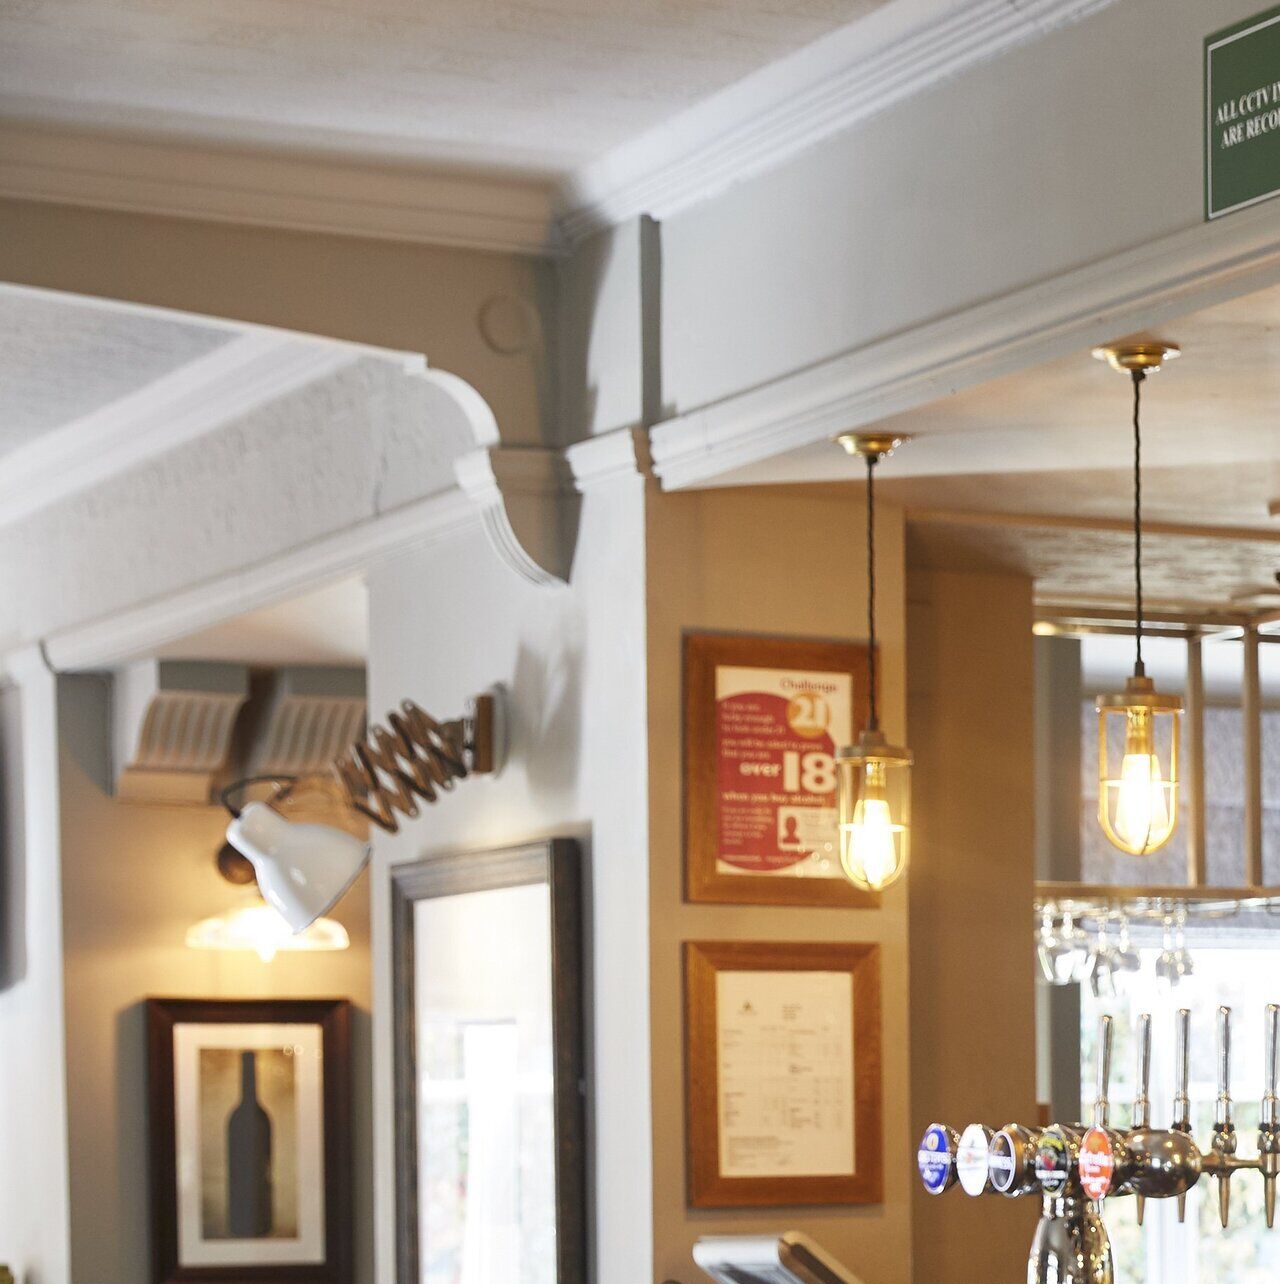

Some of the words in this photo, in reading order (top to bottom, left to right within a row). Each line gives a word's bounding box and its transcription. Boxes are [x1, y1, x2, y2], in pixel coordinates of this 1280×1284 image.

[1215, 101, 1239, 126] ALL
[1239, 85, 1272, 116] CCTV
[1221, 123, 1244, 149] ARE
[781, 679, 838, 694] Challenge
[795, 695, 826, 728] 21
[740, 762, 781, 777] over
[782, 751, 837, 794] 18
